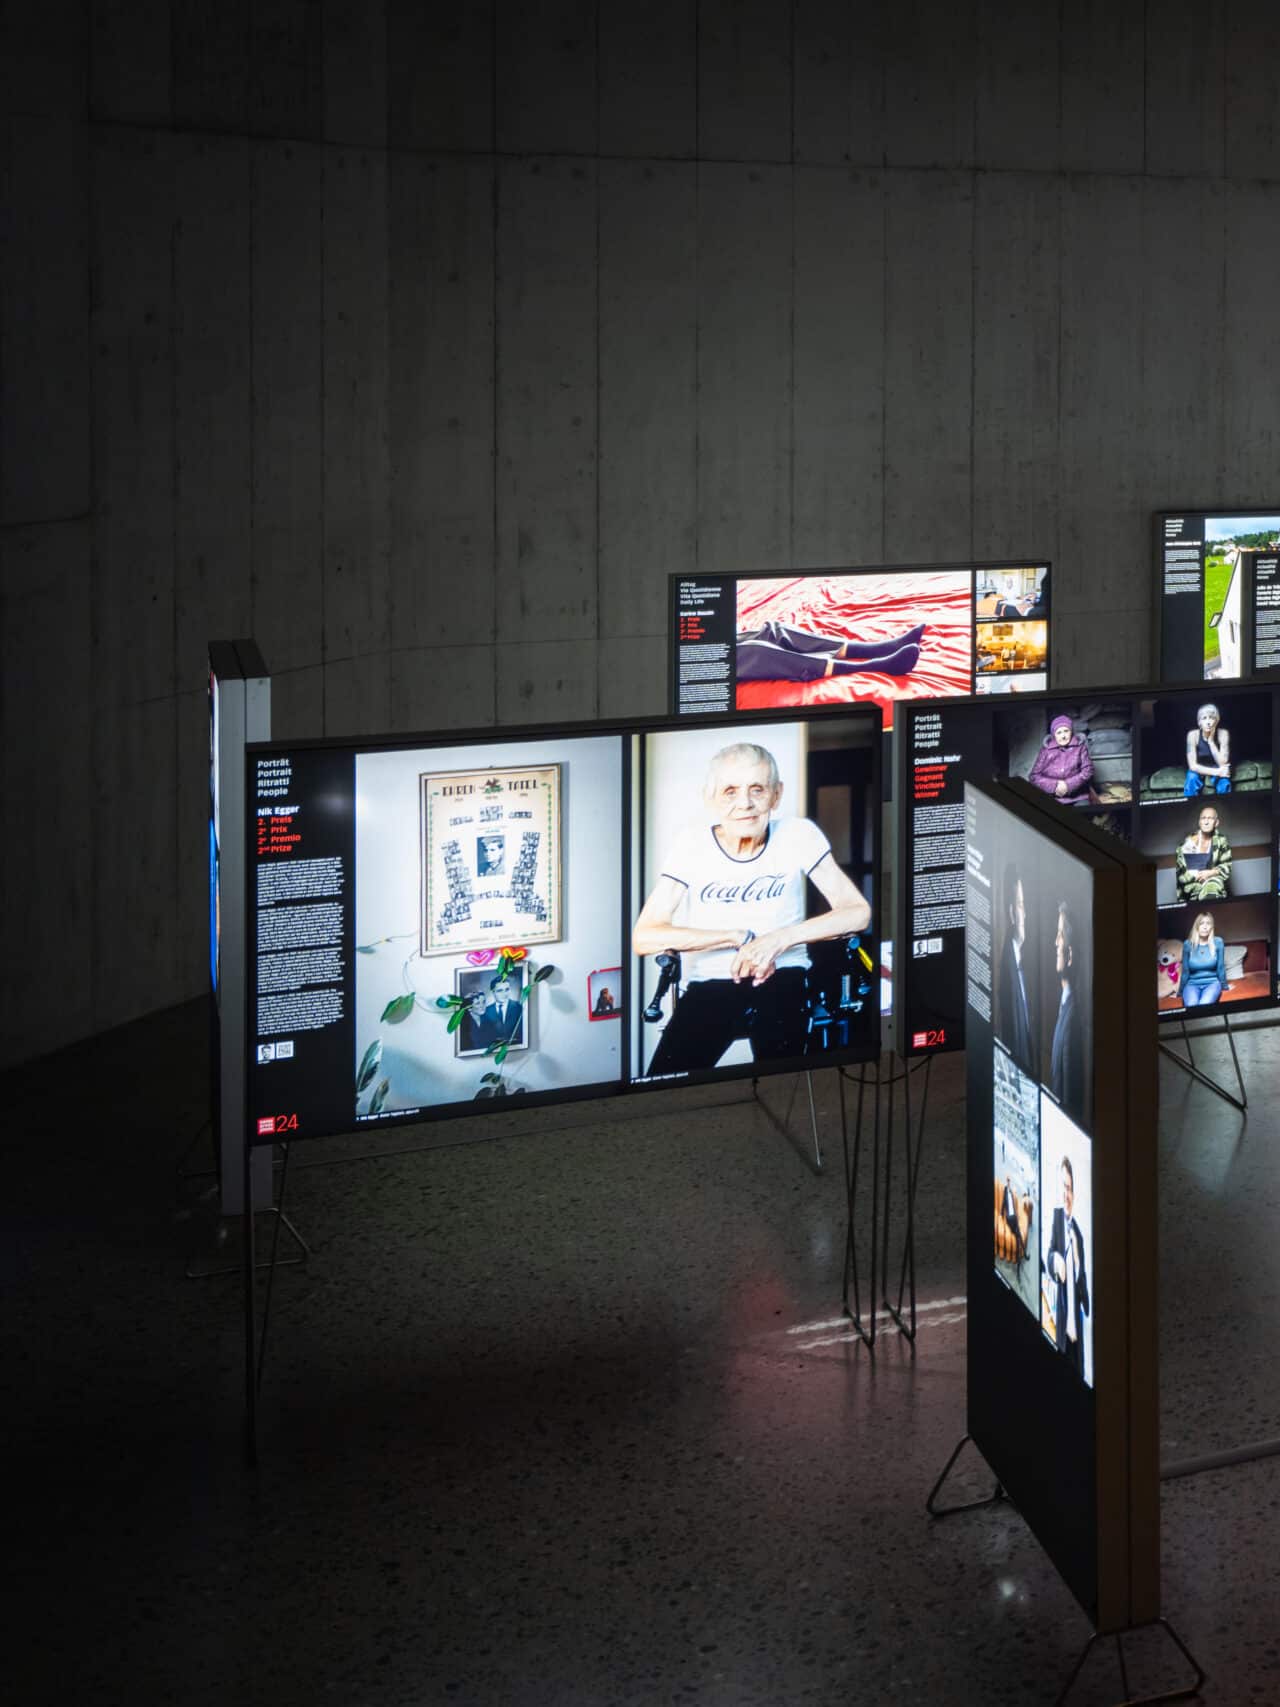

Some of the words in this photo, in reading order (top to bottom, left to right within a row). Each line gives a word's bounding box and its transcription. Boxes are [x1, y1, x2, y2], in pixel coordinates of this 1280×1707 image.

[914, 722, 942, 731] Portrait
[914, 740, 939, 748] People
[257, 758, 290, 769] Porträt
[257, 768, 292, 778] Portrait
[257, 777, 290, 788] Ritratti
[257, 787, 288, 797] People
[257, 807, 273, 817] Nik
[275, 805, 300, 816] Egger
[270, 816, 293, 825] Preis
[270, 826, 288, 834] Prix
[270, 834, 302, 843] Premio
[270, 844, 292, 853] Prize
[927, 1029, 946, 1046] 24
[276, 1113, 299, 1133] 24
